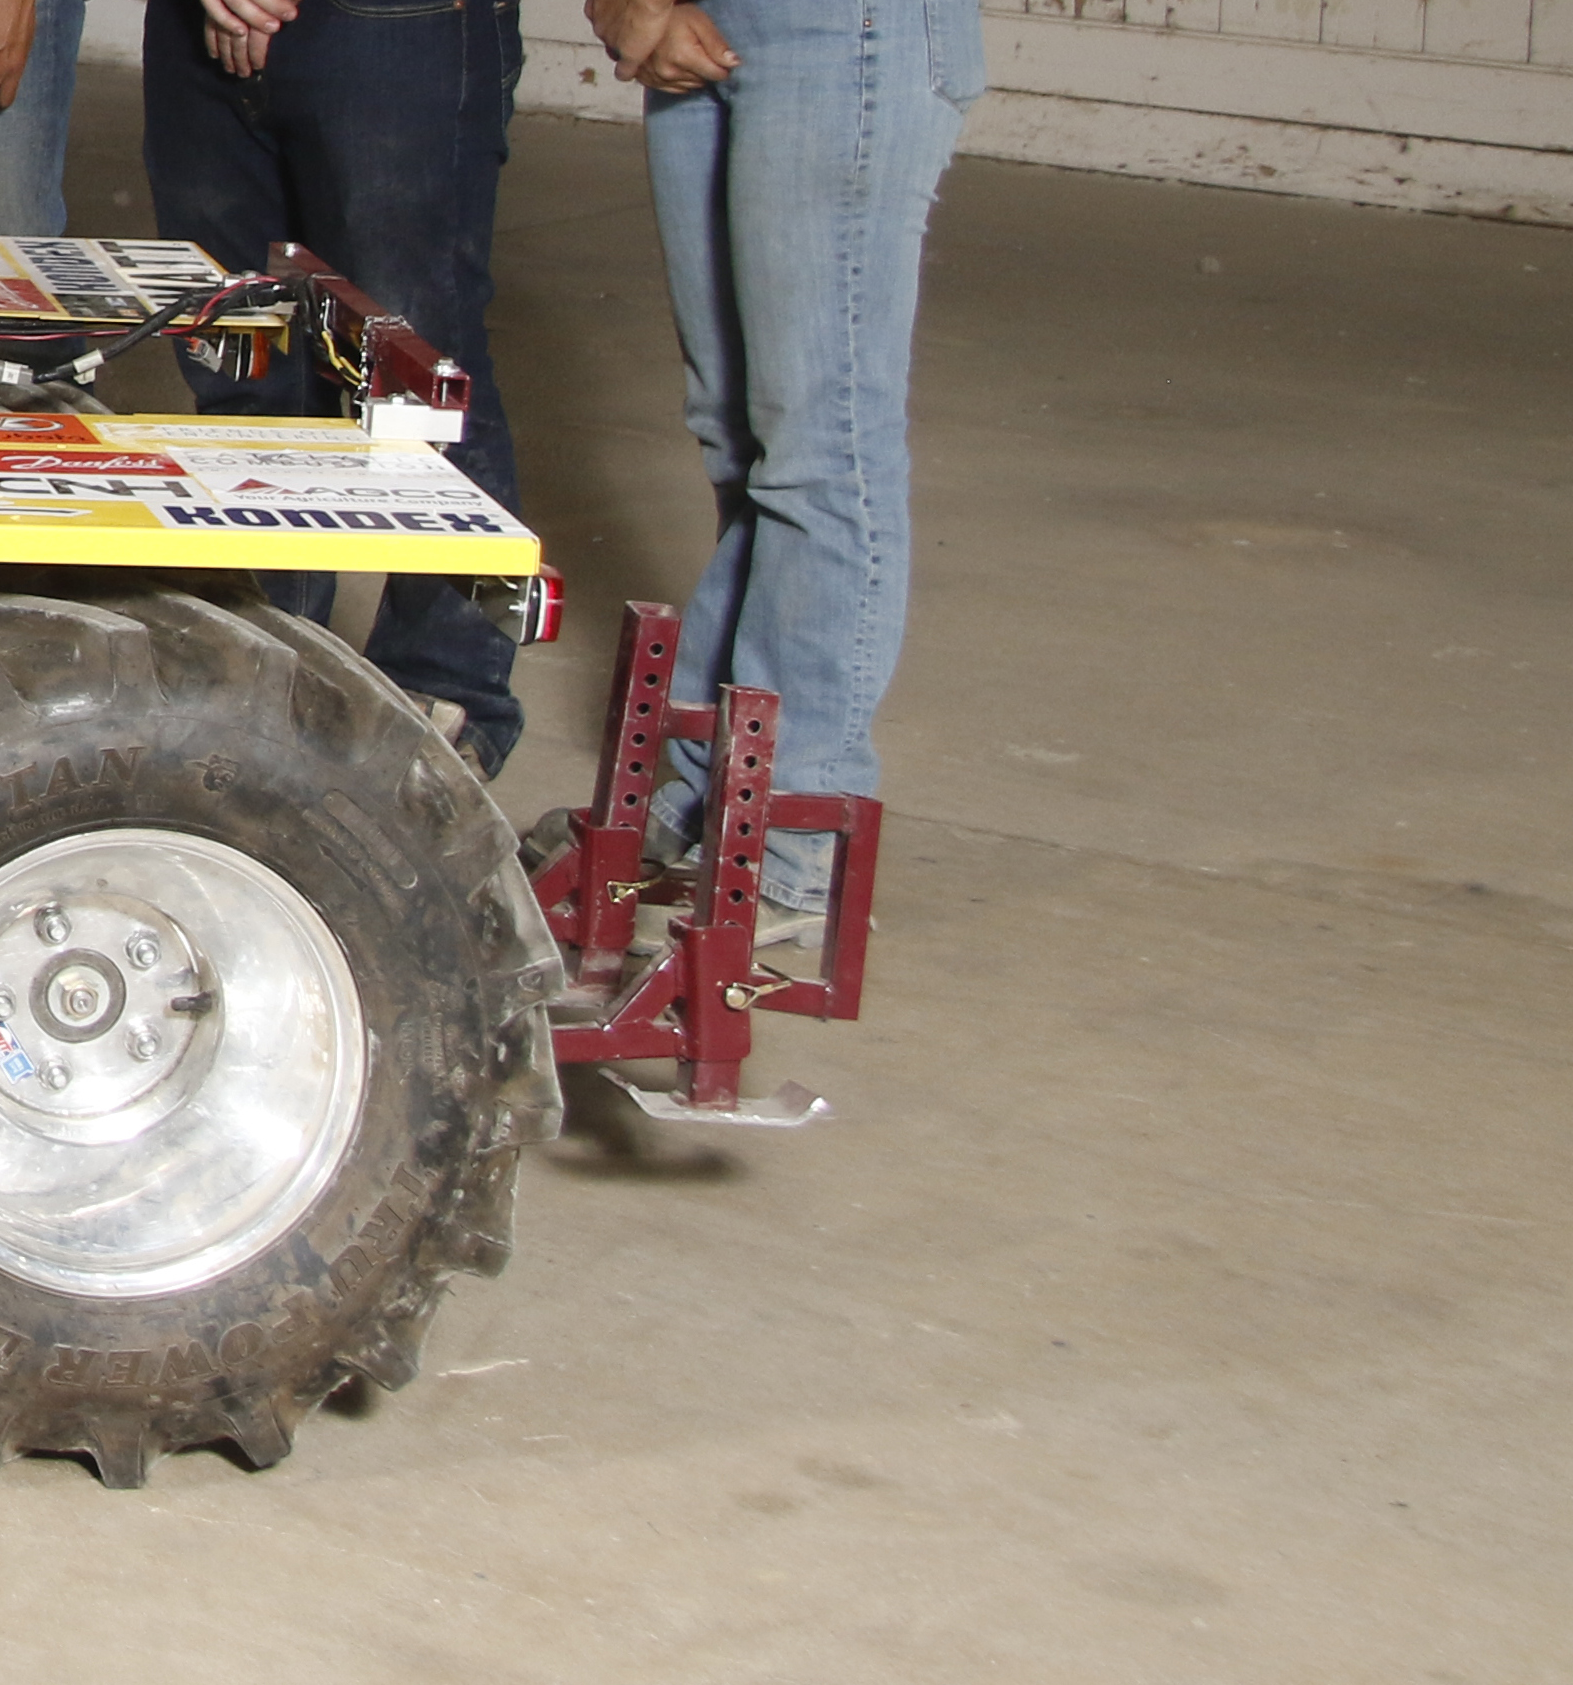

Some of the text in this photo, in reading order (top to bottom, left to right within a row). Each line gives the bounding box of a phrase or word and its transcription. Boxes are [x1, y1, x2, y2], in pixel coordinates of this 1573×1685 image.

[1, 455, 166, 470] Danfoss
[299, 487, 483, 500] AGCO
[280, 494, 393, 505] Agriculture
[395, 497, 483, 508] Company
[163, 504, 504, 533] KONDEX
